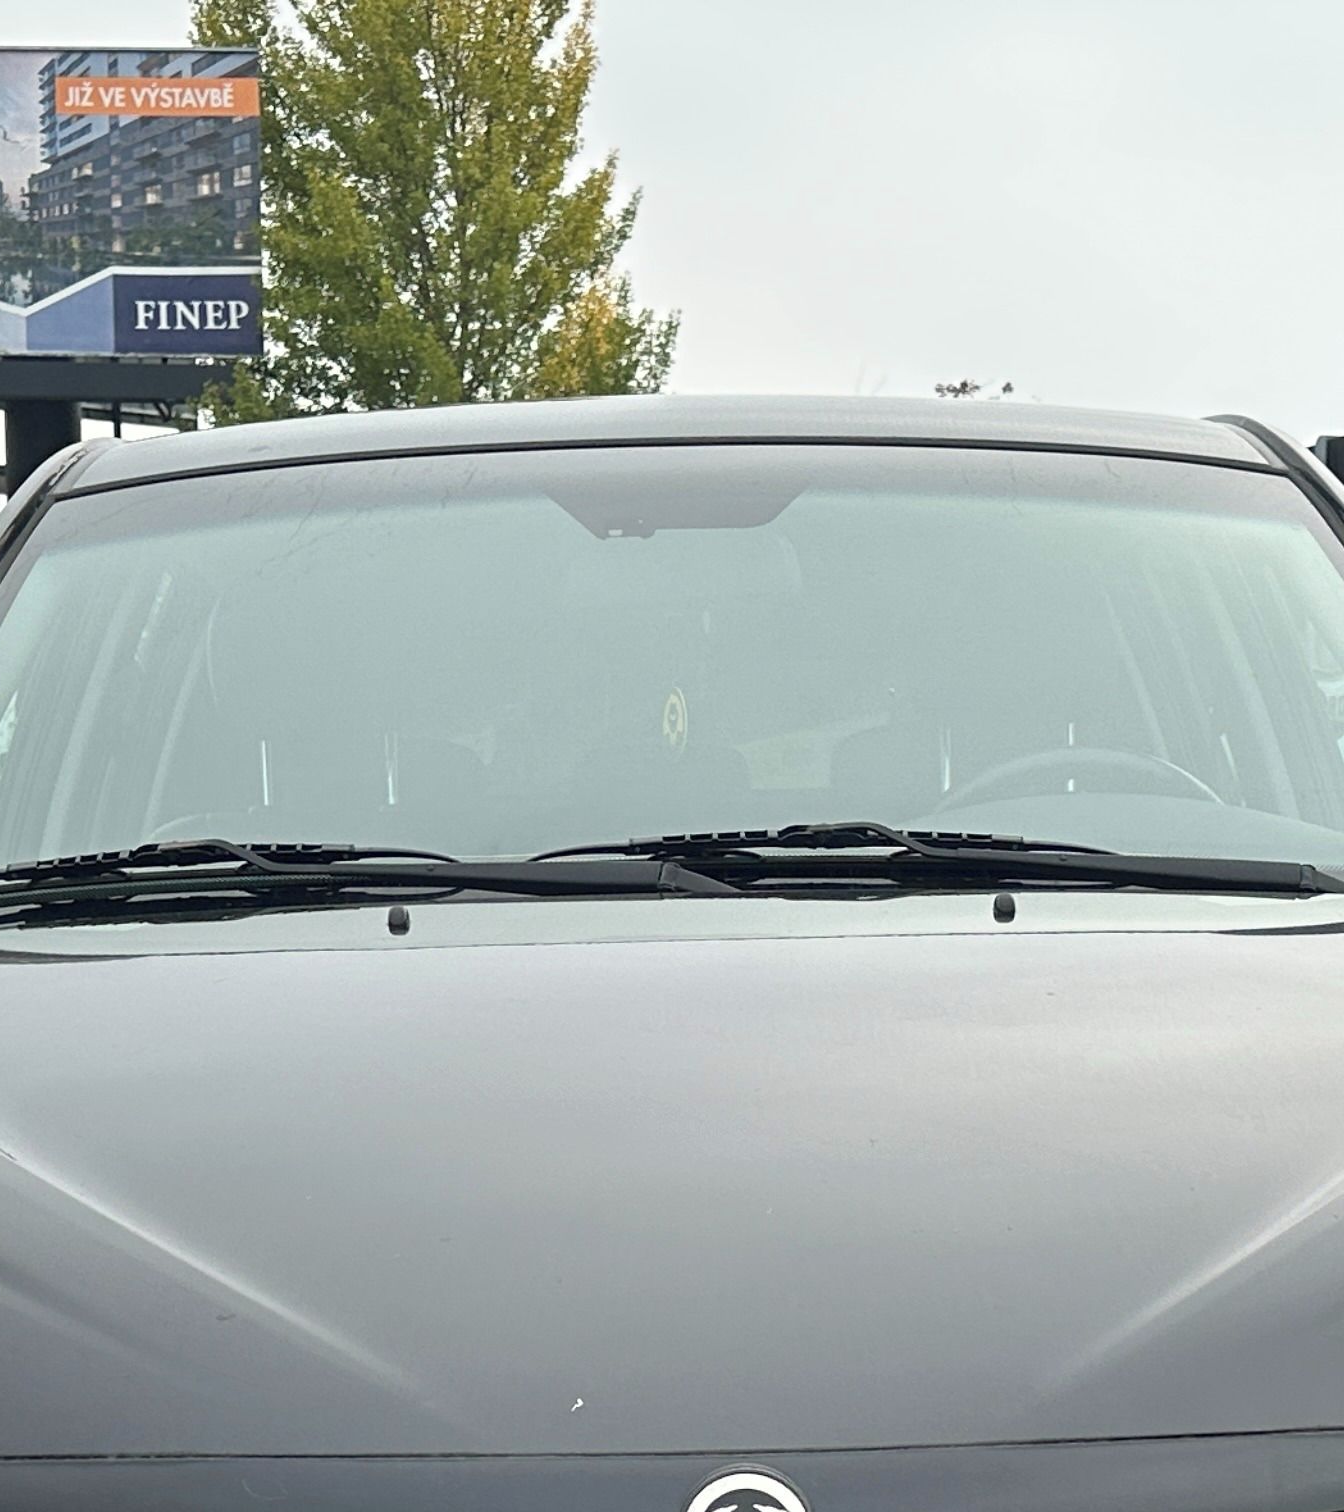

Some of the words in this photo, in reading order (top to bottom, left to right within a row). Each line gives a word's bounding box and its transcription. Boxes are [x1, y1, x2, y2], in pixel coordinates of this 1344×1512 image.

[64, 81, 93, 107] JIŽ
[98, 86, 126, 107] VE
[130, 82, 235, 108] VÝSTAVBĚ
[134, 300, 250, 330] FINEP
